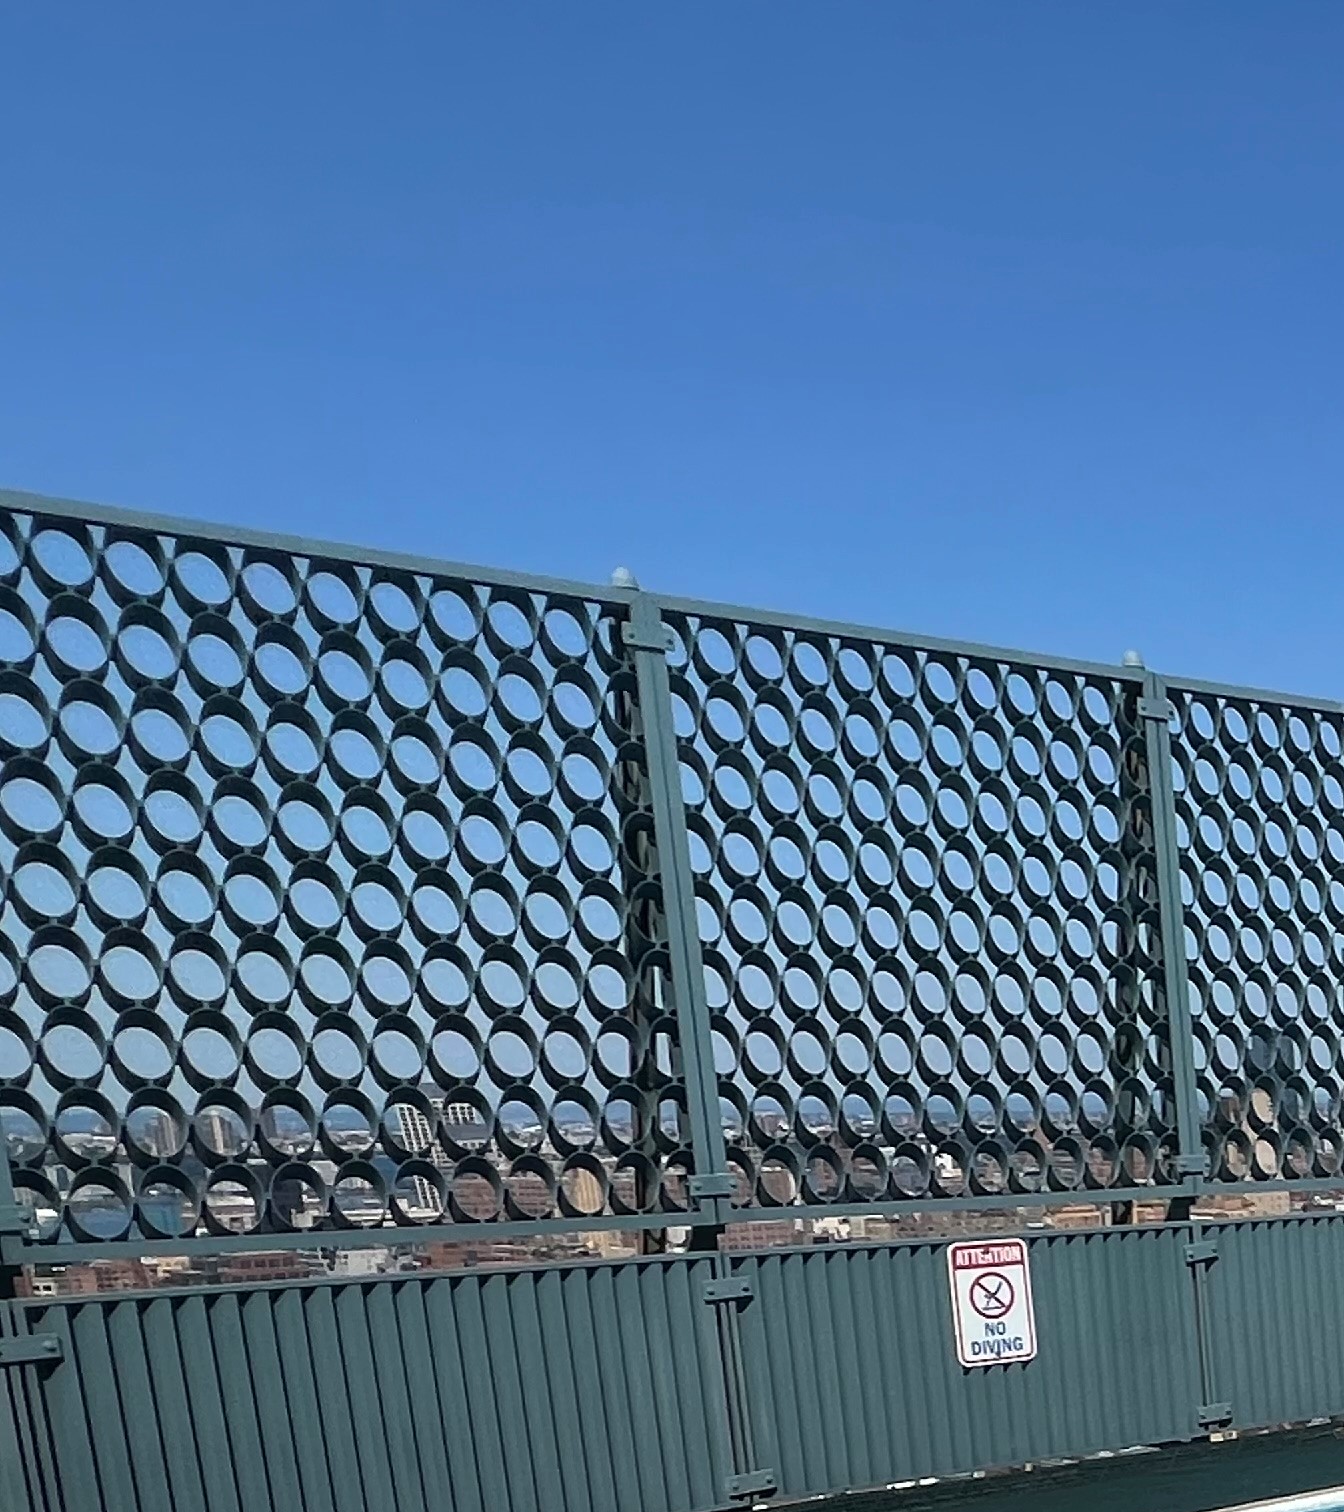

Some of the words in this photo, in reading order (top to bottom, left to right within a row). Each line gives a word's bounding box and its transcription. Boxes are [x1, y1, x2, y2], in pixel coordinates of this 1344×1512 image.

[956, 1246, 1022, 1266] ATTENTION
[985, 1321, 1006, 1336] NO
[971, 1337, 1024, 1356] DIVING
